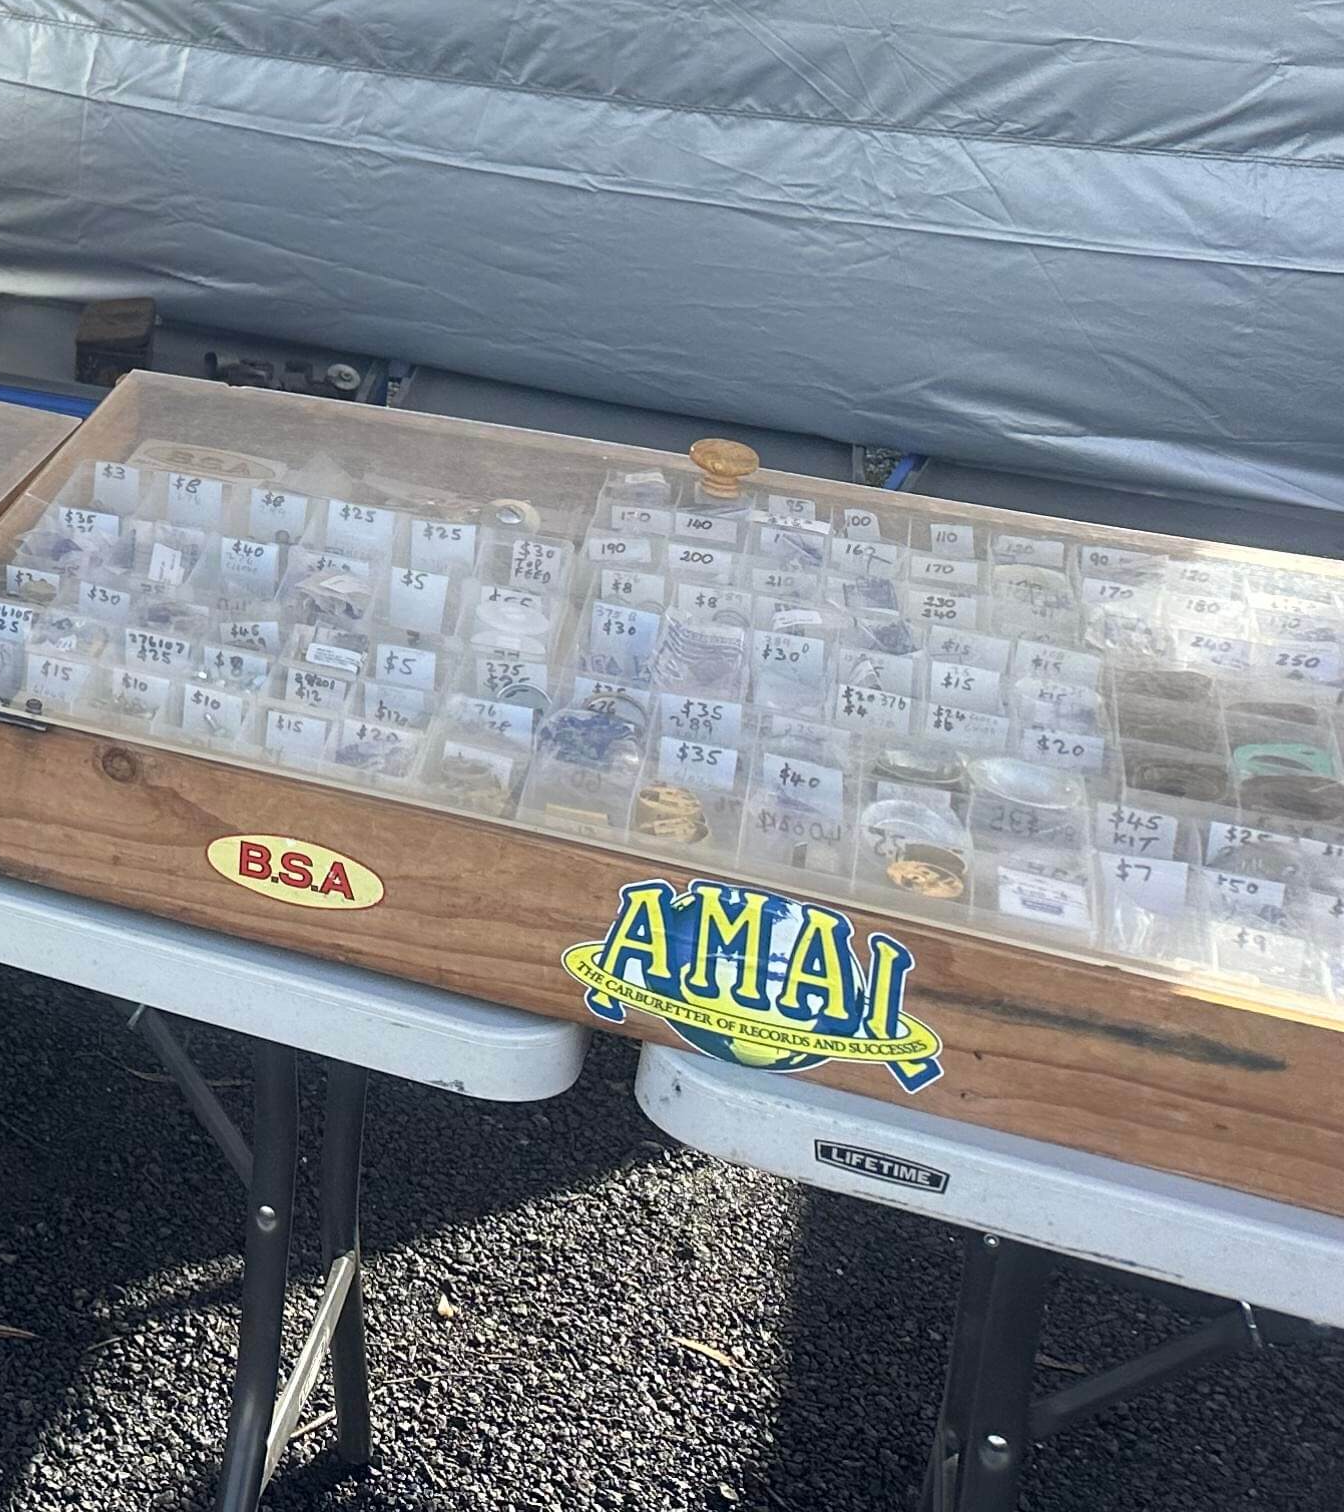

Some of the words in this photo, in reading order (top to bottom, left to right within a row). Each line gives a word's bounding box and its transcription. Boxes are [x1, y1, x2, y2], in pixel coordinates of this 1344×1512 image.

[102, 463, 127, 481] $3
[340, 504, 377, 524] $25
[686, 517, 713, 530] 140
[423, 522, 462, 541] $25
[935, 531, 958, 543] 110
[231, 538, 264, 557] $40
[518, 540, 554, 560] $30
[601, 542, 626, 555] 190
[679, 550, 714, 565] 200
[1089, 552, 1109, 566] 90
[925, 563, 954, 574] 170
[401, 569, 429, 591] $5
[611, 580, 633, 594] $8
[87, 587, 121, 605] $30
[695, 592, 718, 609] $8
[1100, 585, 1134, 599] 170
[603, 619, 637, 636] $30
[137, 647, 171, 664] $25
[384, 651, 417, 675] $5
[1275, 653, 1321, 669] 250
[41, 661, 73, 681] $15
[121, 673, 148, 691] $10
[940, 672, 975, 691] $15
[192, 691, 221, 710] $10
[681, 698, 723, 721] $35
[275, 714, 304, 734] $15
[676, 742, 722, 766] $35
[1036, 735, 1085, 757] $20
[779, 763, 820, 788] $40
[1108, 806, 1163, 830] $45
[1113, 831, 1161, 852] KIT
[1116, 858, 1152, 882] $7
[586, 881, 940, 1089] AMAL
[576, 960, 604, 984] THE
[605, 978, 713, 1026] CARBURETTER
[716, 1017, 737, 1033] OF
[739, 1023, 811, 1048] RECORDS
[812, 1038, 846, 1053] AND
[848, 1039, 927, 1056] SUCCESSES
[831, 1147, 932, 1185] LIFETIME
